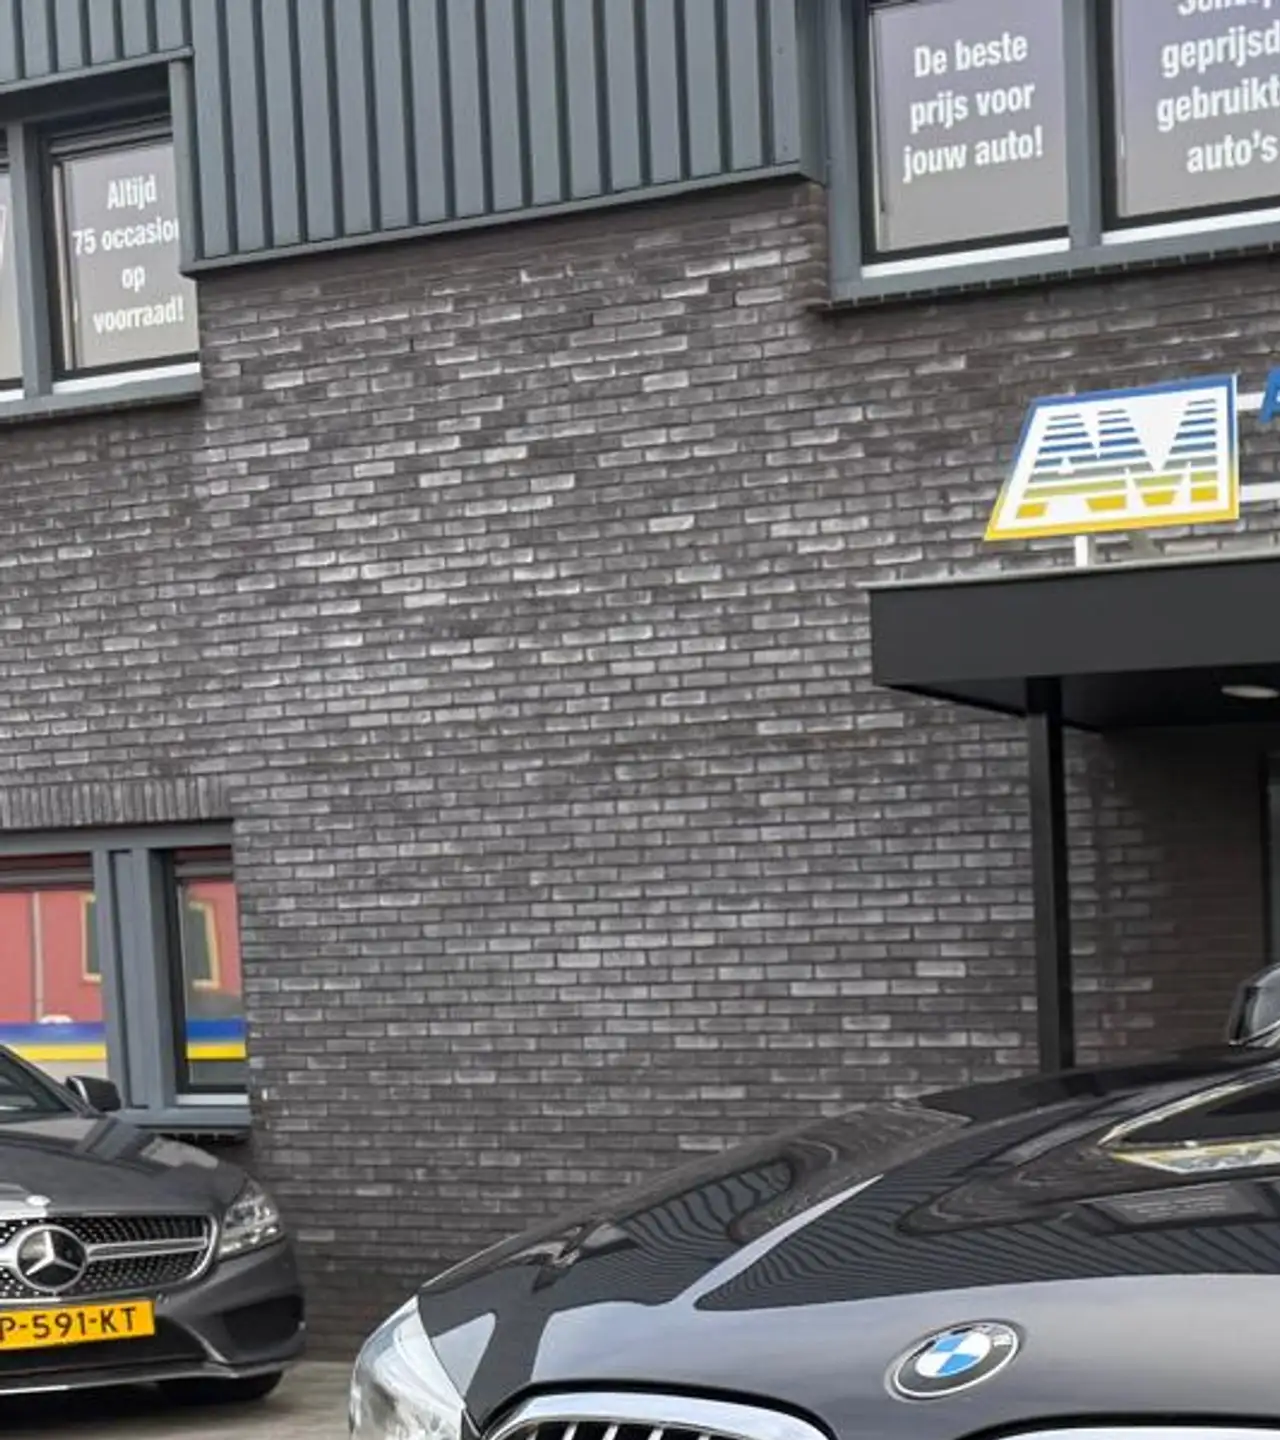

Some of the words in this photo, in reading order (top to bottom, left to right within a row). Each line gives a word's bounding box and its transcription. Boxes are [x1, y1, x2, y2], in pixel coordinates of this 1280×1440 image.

[914, 45, 948, 78] De
[955, 32, 1028, 72] beste
[910, 88, 969, 134] prijs
[975, 81, 1035, 117] voor
[903, 144, 967, 182] jouw
[974, 125, 1043, 169] auto!
[107, 174, 157, 210] Altijd
[72, 228, 97, 255] 75
[122, 266, 146, 292] op
[93, 295, 184, 334] voorraad!
[0, 1307, 136, 1341] P-591-KT
